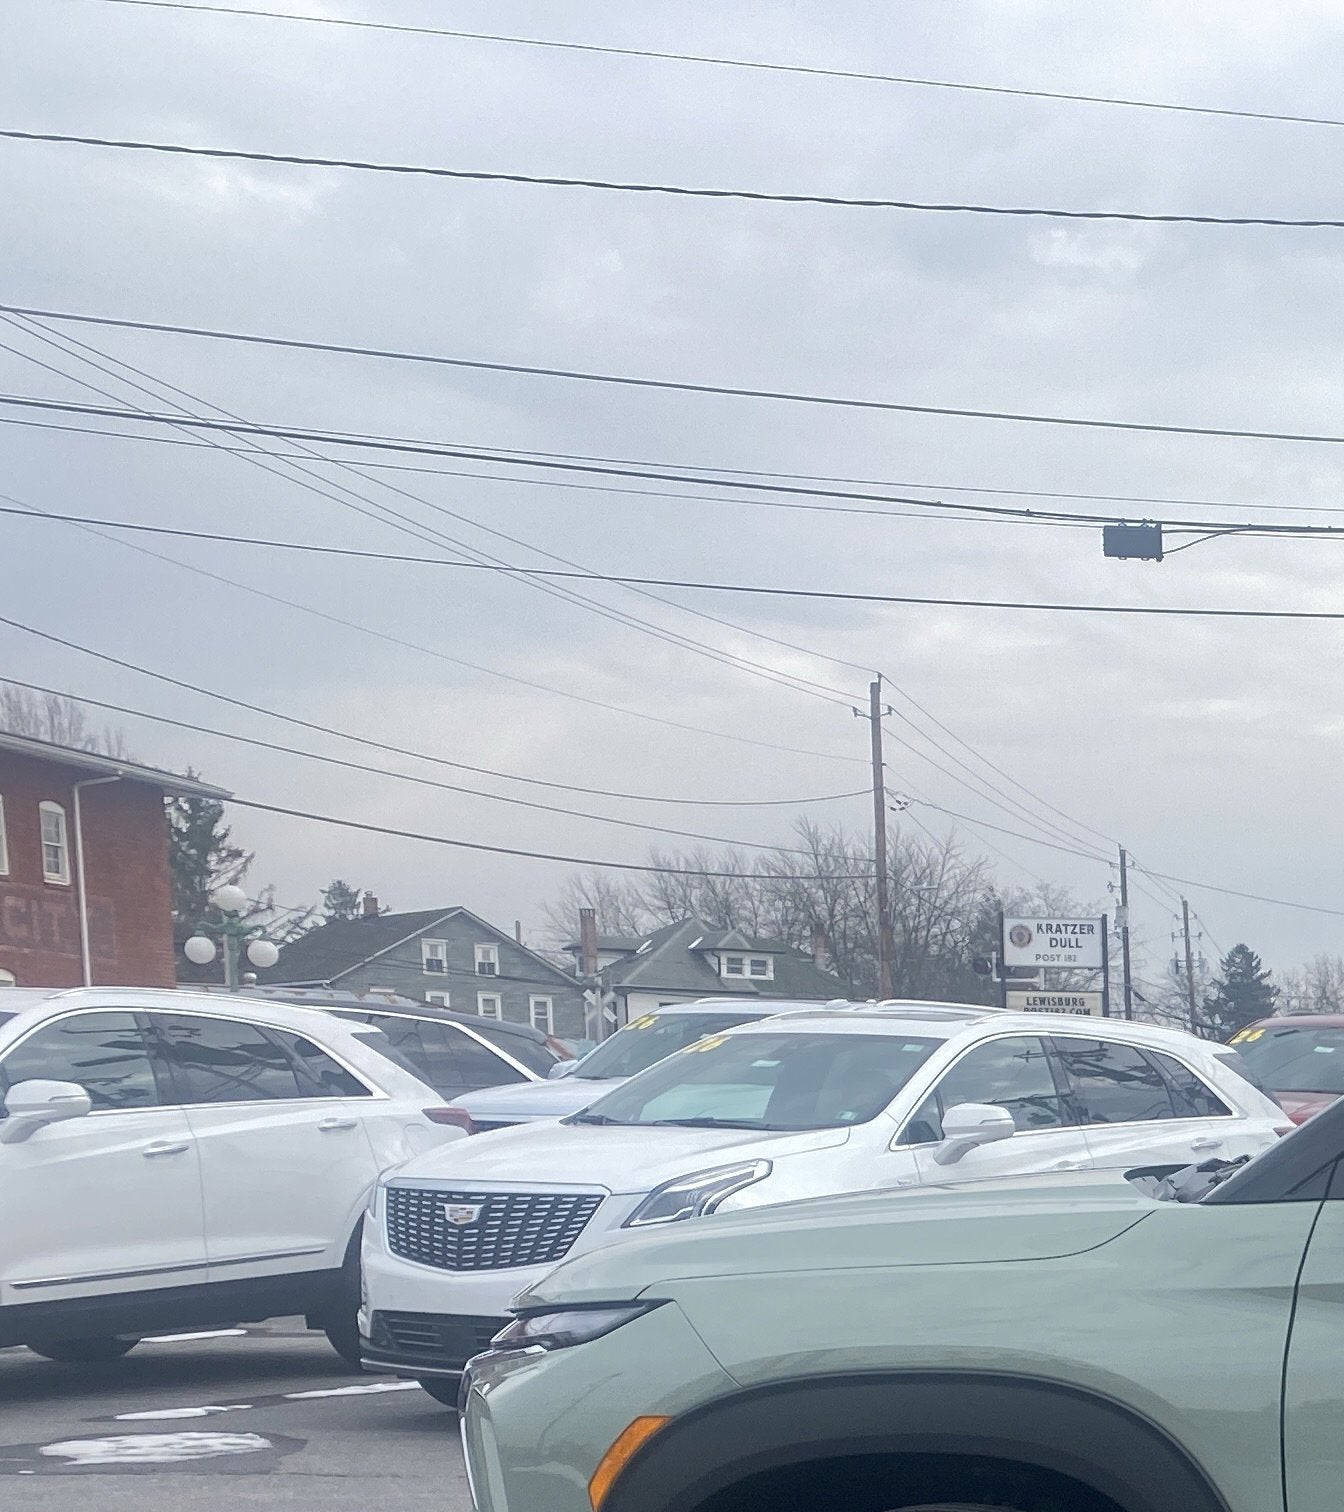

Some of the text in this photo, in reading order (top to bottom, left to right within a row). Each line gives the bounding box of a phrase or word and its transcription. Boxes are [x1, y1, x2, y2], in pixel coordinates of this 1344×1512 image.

[1036, 923, 1095, 935] KRATZER
[1049, 937, 1083, 949] DULL
[1035, 953, 1078, 962] POST 182
[1026, 996, 1086, 1007] LEWISBURG
